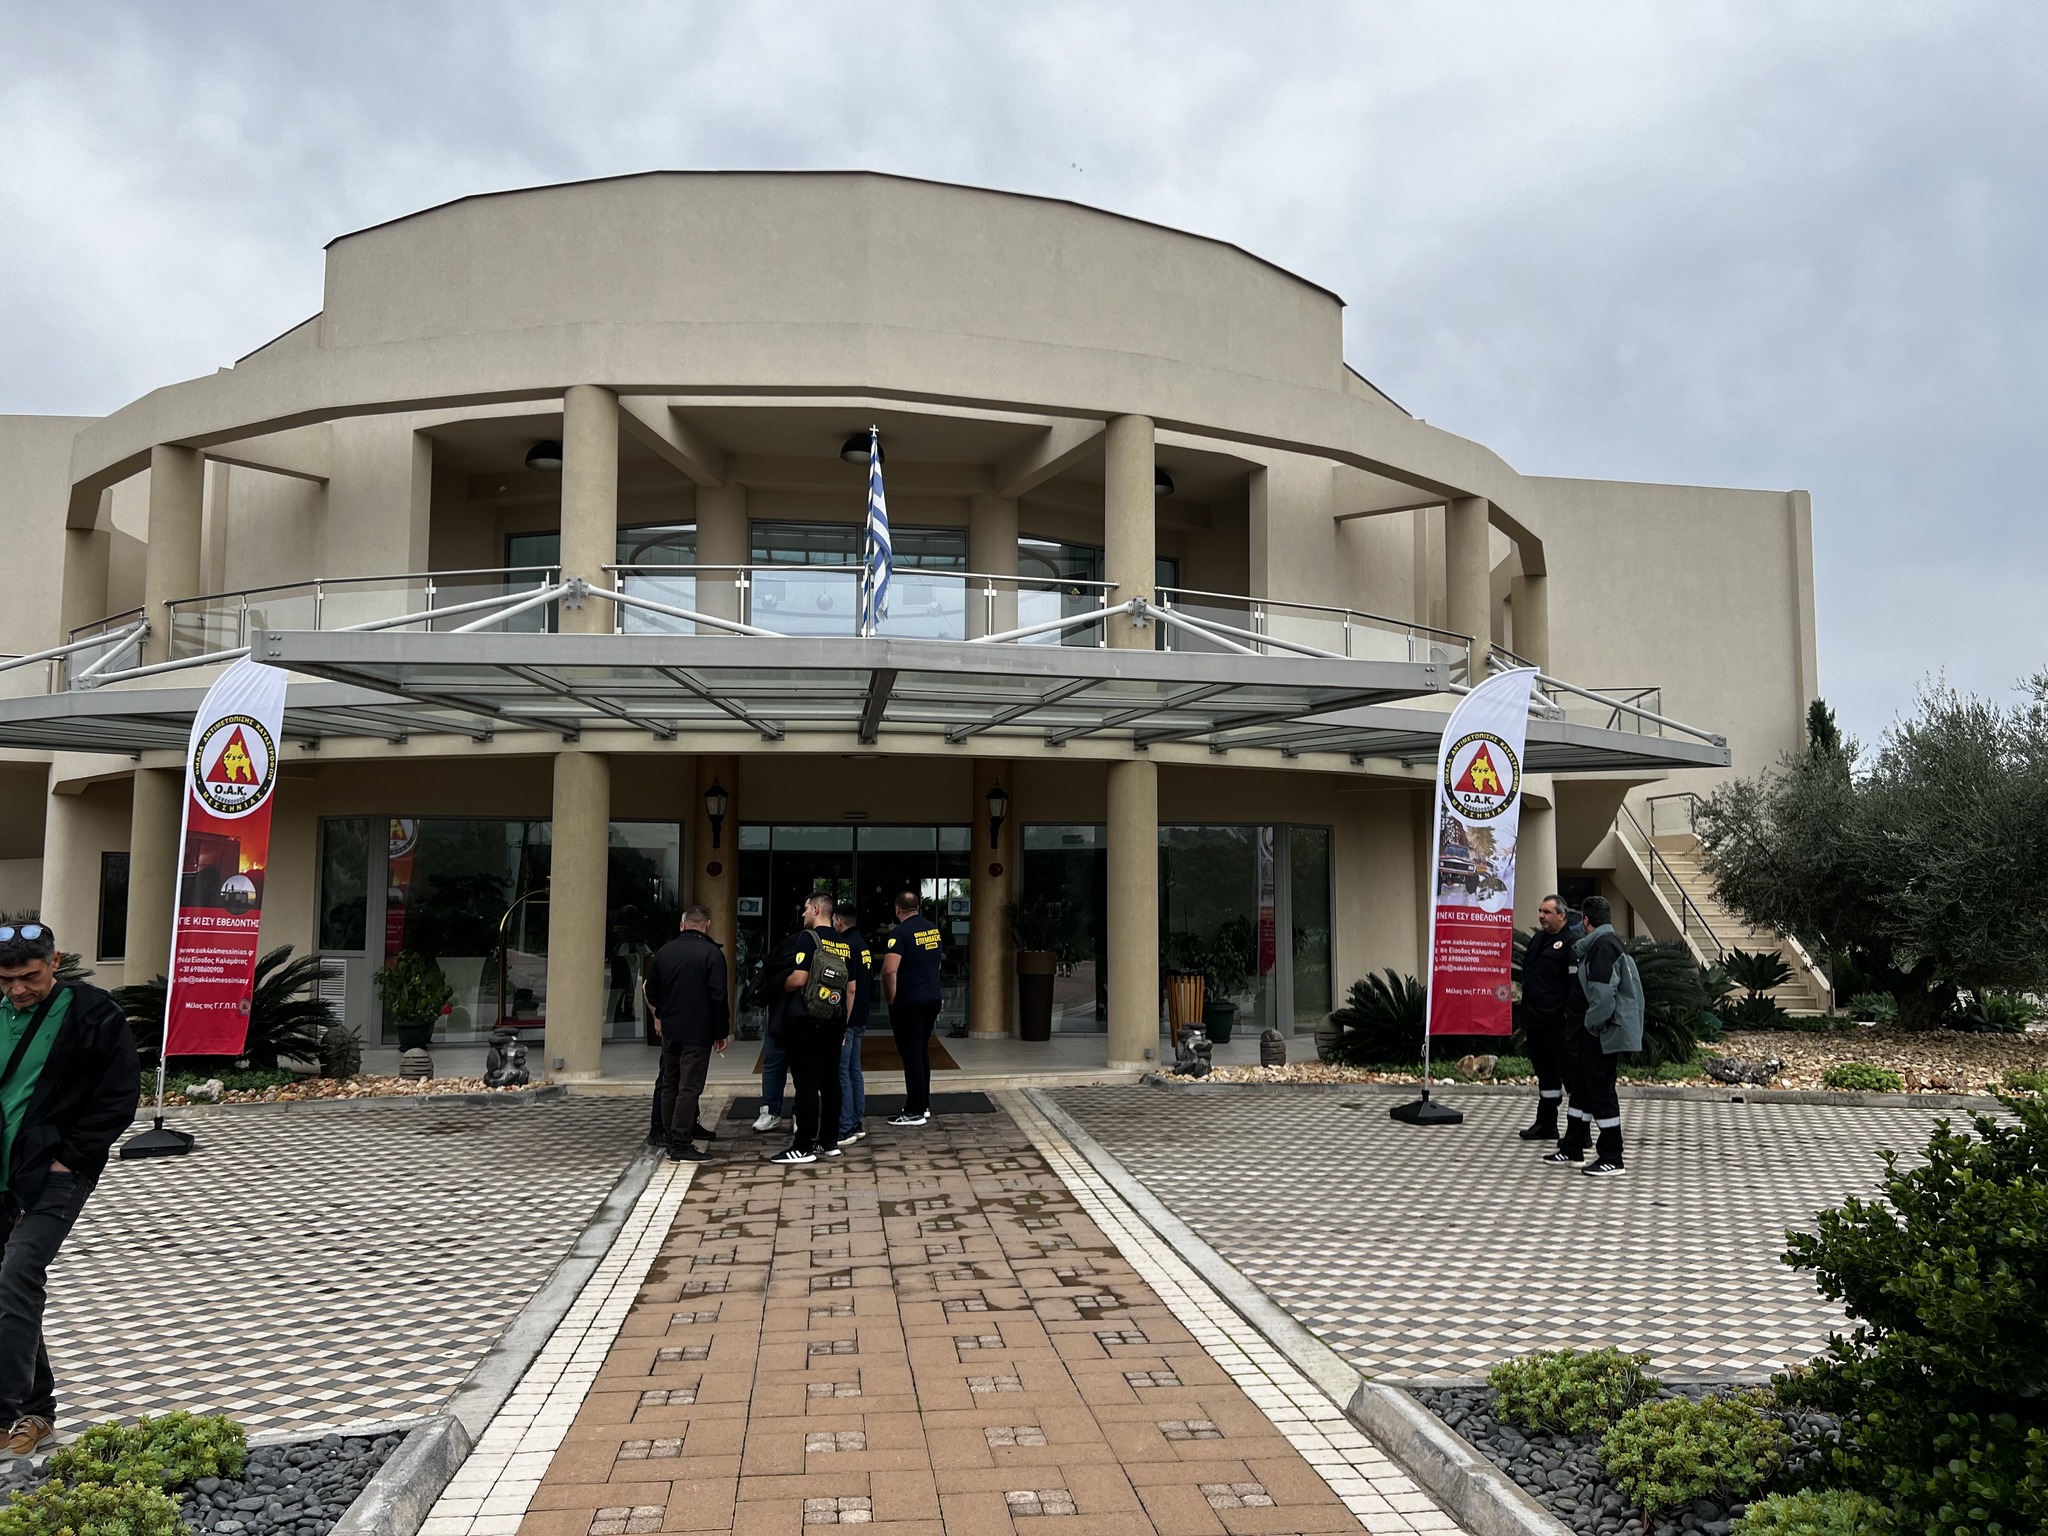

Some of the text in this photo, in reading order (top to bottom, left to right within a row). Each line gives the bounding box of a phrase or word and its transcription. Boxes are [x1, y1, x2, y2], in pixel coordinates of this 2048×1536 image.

[195, 746, 203, 775] ΟΜΑΔΑ
[204, 716, 254, 742] ΑΝΤΙΜΕΤΩΠΙΣΗΣ
[214, 784, 247, 795] Ο.Α.Κ.
[202, 792, 262, 812] ΜΕΣΣΗΝΙΑΣ
[1464, 794, 1494, 805] Ο.Α.Κ.
[1452, 799, 1508, 819] ΜΕΣΣΗΝΙΑΣ
[193, 917, 200, 925] ΚΙ
[202, 917, 215, 926] ΕΣΥ
[217, 918, 259, 928] ΕΘΕΛΟΝΤΗΣ
[1457, 912, 1469, 920] ΕΣΥ
[1471, 913, 1512, 922] ΕΘΕΛΟΝΤΗΣ
